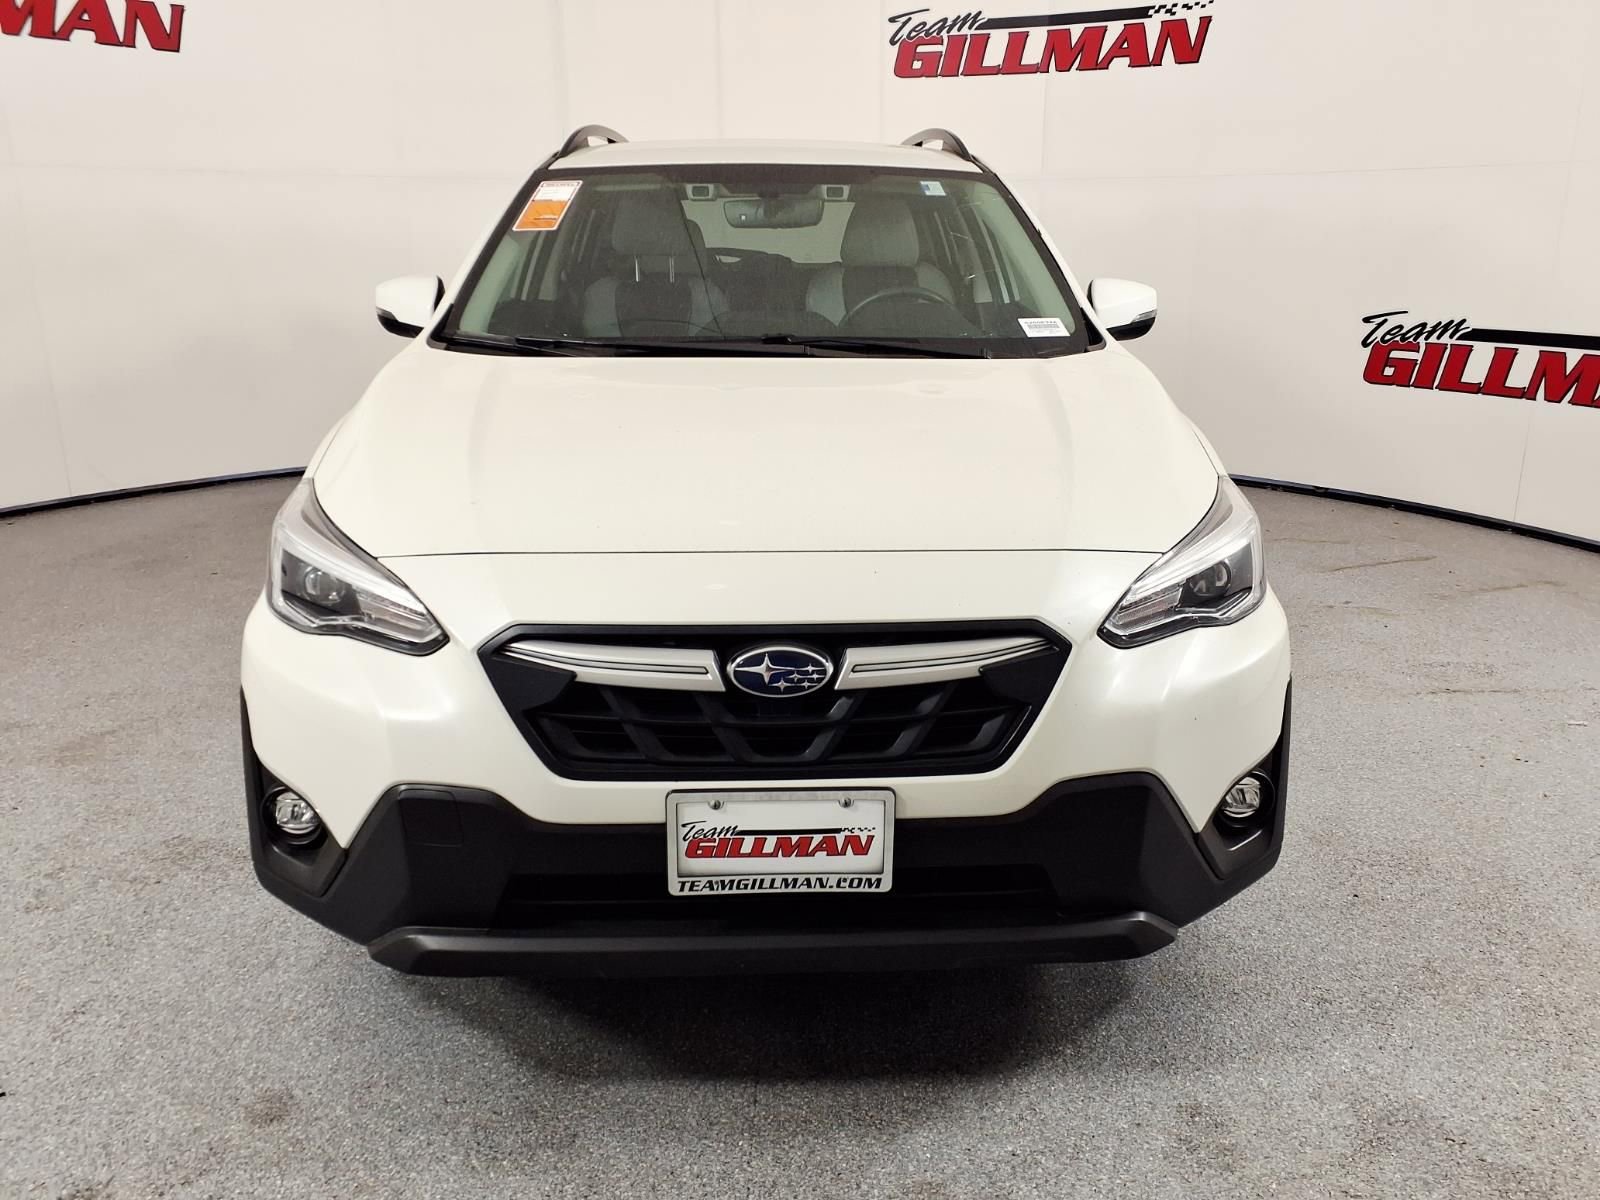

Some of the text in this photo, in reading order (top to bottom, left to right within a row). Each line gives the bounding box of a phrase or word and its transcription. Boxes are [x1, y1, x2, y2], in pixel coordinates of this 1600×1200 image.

[888, 9, 987, 46] Team
[894, 16, 1212, 78] GILLMAN
[1361, 310, 1470, 348] Team
[1363, 340, 1600, 409] GILLM
[681, 820, 738, 842] Team
[685, 835, 875, 858] GILLMAN
[678, 877, 882, 893] TEAMGILLMAN.COM
